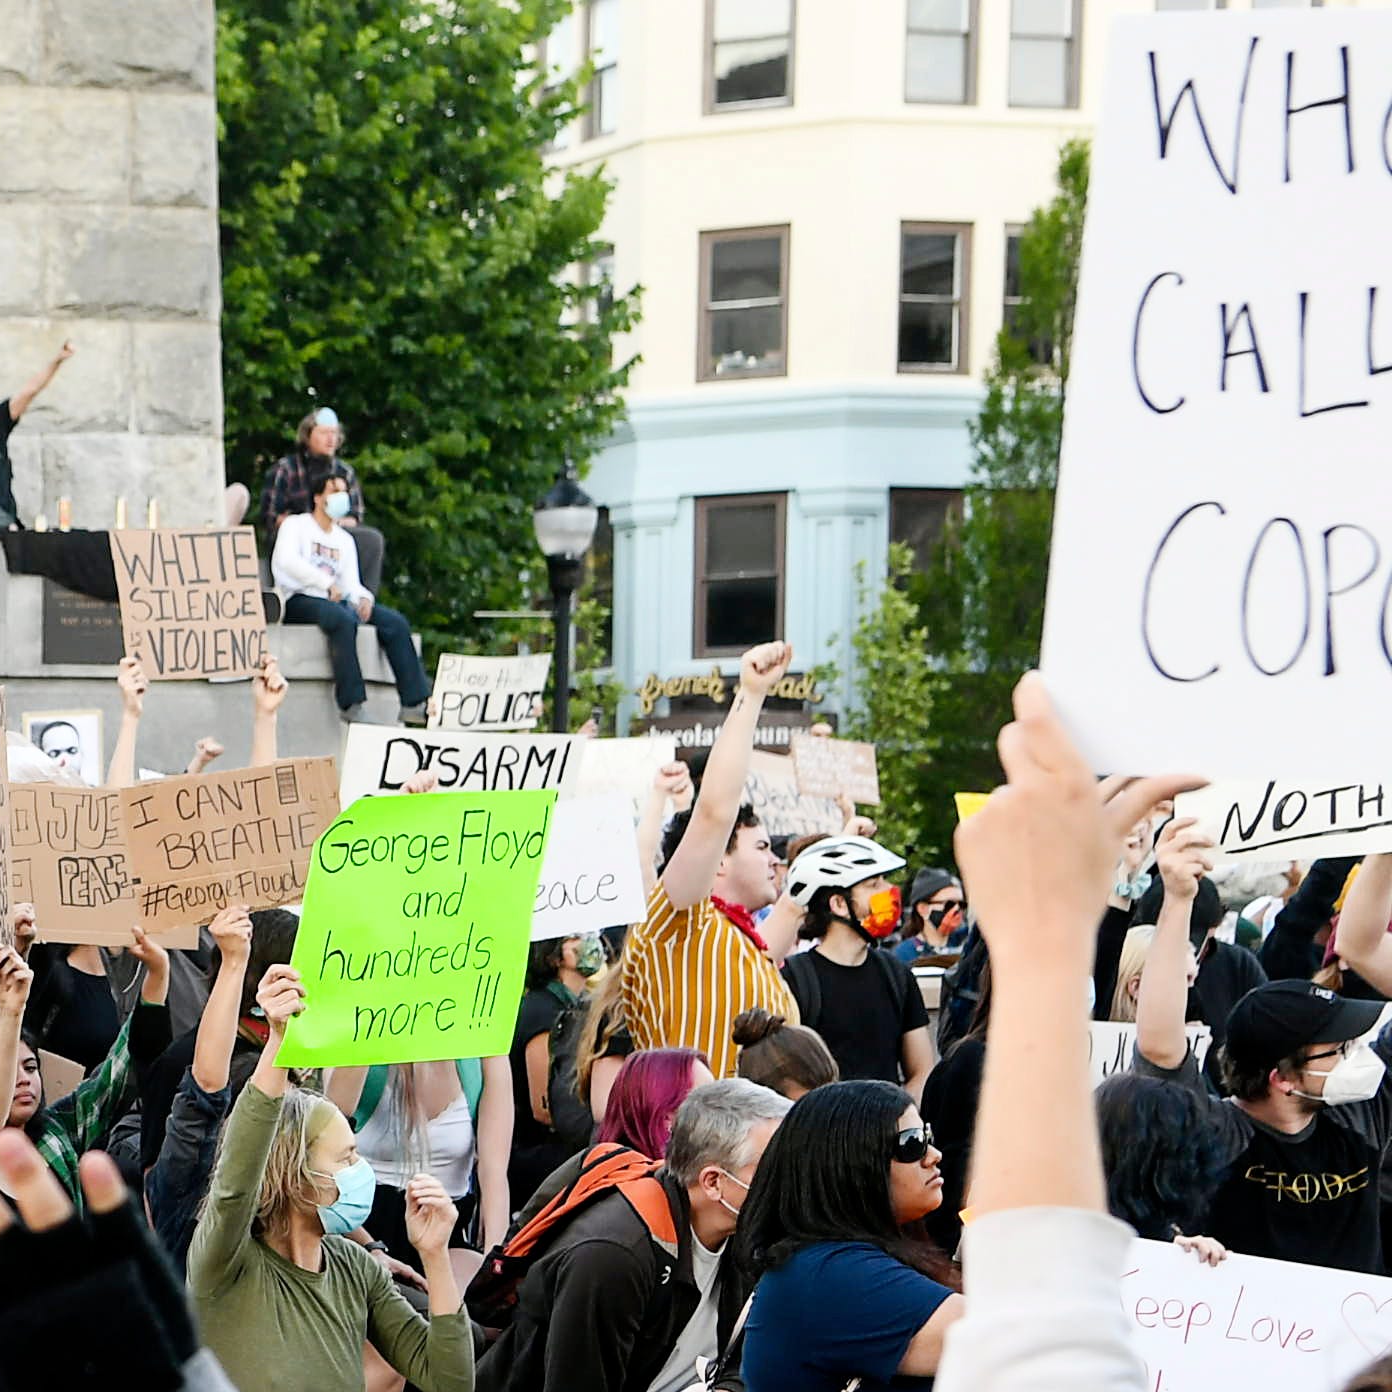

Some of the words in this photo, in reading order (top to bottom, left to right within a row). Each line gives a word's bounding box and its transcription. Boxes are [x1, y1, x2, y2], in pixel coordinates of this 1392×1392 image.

[1148, 36, 1392, 195] WH
[115, 531, 258, 586] WHITE
[129, 587, 257, 623] SILENCE
[147, 628, 266, 675] VIOLENCE
[438, 691, 542, 727] POLICE
[637, 666, 726, 714] french
[130, 796, 160, 829] I
[176, 775, 272, 821] CAN'T
[156, 812, 317, 870] BREATHE
[319, 819, 449, 875] George
[458, 805, 549, 869] Floyd
[402, 872, 467, 918] and
[532, 873, 618, 913] eace
[319, 922, 494, 982] hundreds
[1120, 1269, 1212, 1344] eep
[1225, 1285, 1320, 1352] Love
